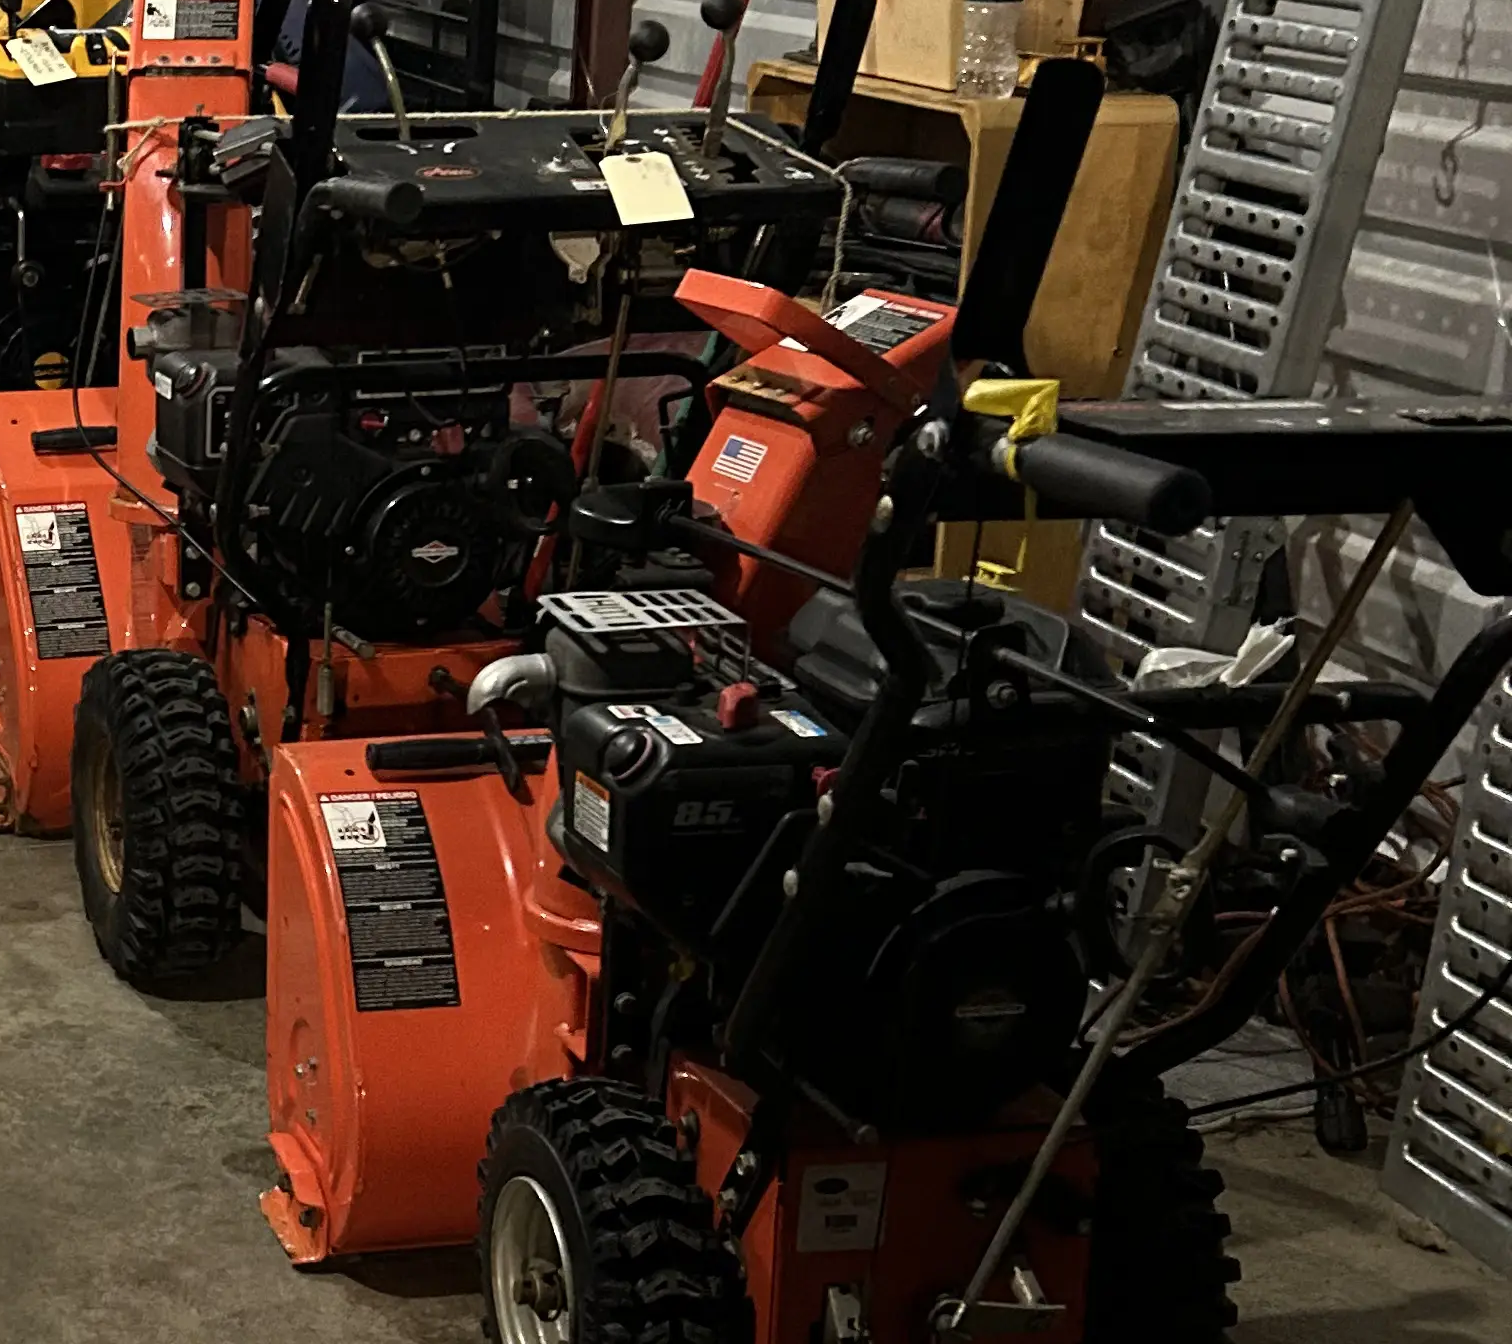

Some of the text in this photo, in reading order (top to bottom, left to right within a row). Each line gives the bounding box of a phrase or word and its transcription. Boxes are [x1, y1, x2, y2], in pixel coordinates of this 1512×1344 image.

[580, 599, 638, 619] HOT
[330, 794, 370, 802] DANGER
[375, 791, 418, 800] PELIGRO
